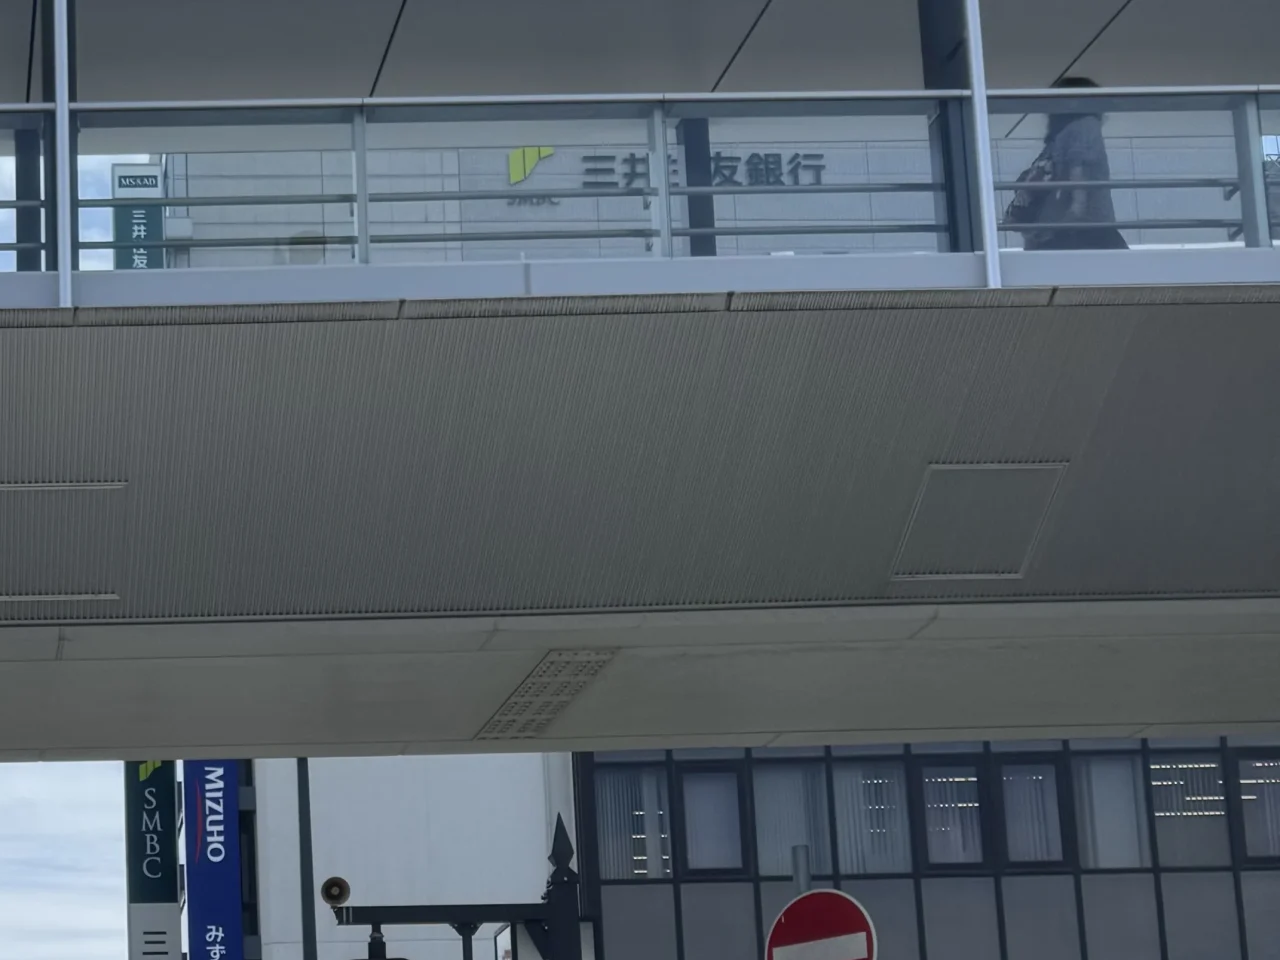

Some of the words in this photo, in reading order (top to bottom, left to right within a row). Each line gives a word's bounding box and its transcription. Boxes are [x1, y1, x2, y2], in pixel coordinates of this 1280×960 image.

[582, 152, 827, 188] 三井友銀行
[140, 787, 163, 879] SMBC
[204, 766, 226, 863] MIZUHO
